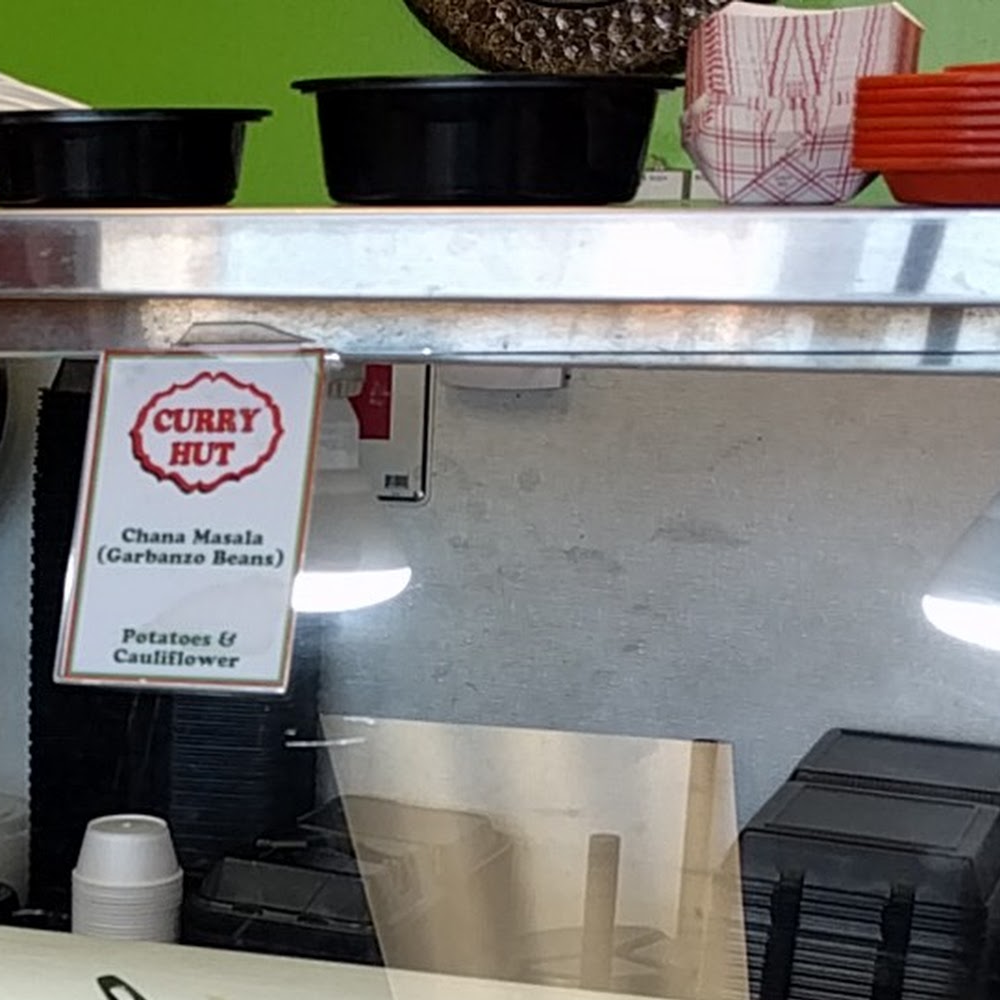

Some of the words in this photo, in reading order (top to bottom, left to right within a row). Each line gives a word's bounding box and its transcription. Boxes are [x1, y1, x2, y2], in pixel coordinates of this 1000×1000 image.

[152, 408, 260, 434] CURRY
[168, 442, 235, 466] HUT
[121, 528, 186, 544] Chana
[192, 529, 264, 545] Masala
[97, 548, 206, 566] (Garbanzo
[212, 549, 284, 567] Beans)
[121, 629, 212, 646] Potatoes
[218, 632, 237, 646] &
[113, 649, 240, 668] Cauliflower
